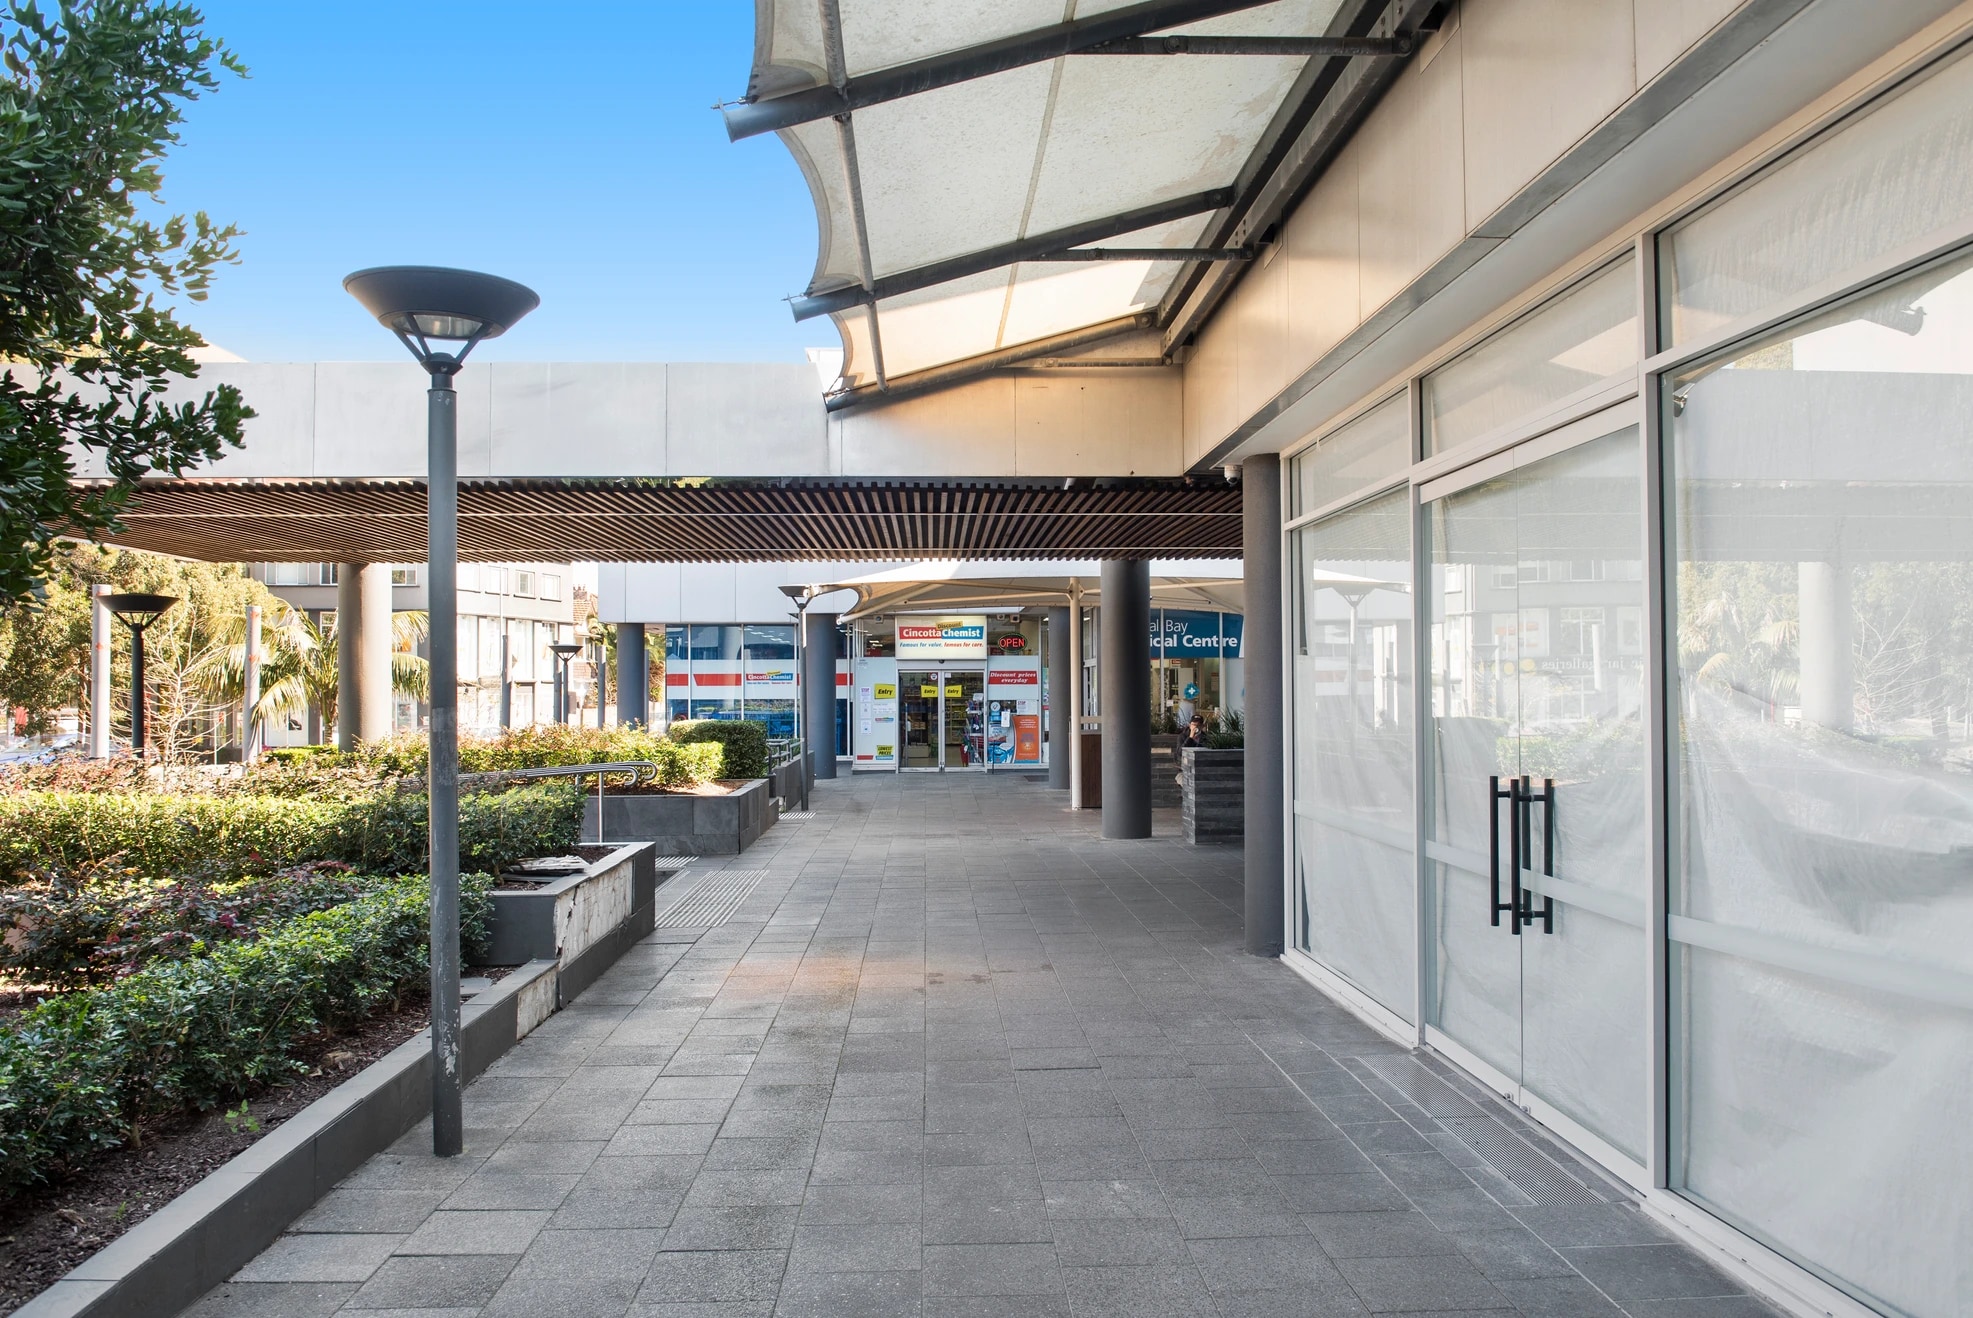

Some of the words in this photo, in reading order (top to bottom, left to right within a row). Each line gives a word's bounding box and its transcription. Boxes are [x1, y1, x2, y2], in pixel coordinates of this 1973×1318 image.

[937, 621, 961, 629] Discount
[1165, 619, 1188, 635] Bay
[999, 638, 1025, 648] OPEN
[1182, 634, 1238, 647] Centre
